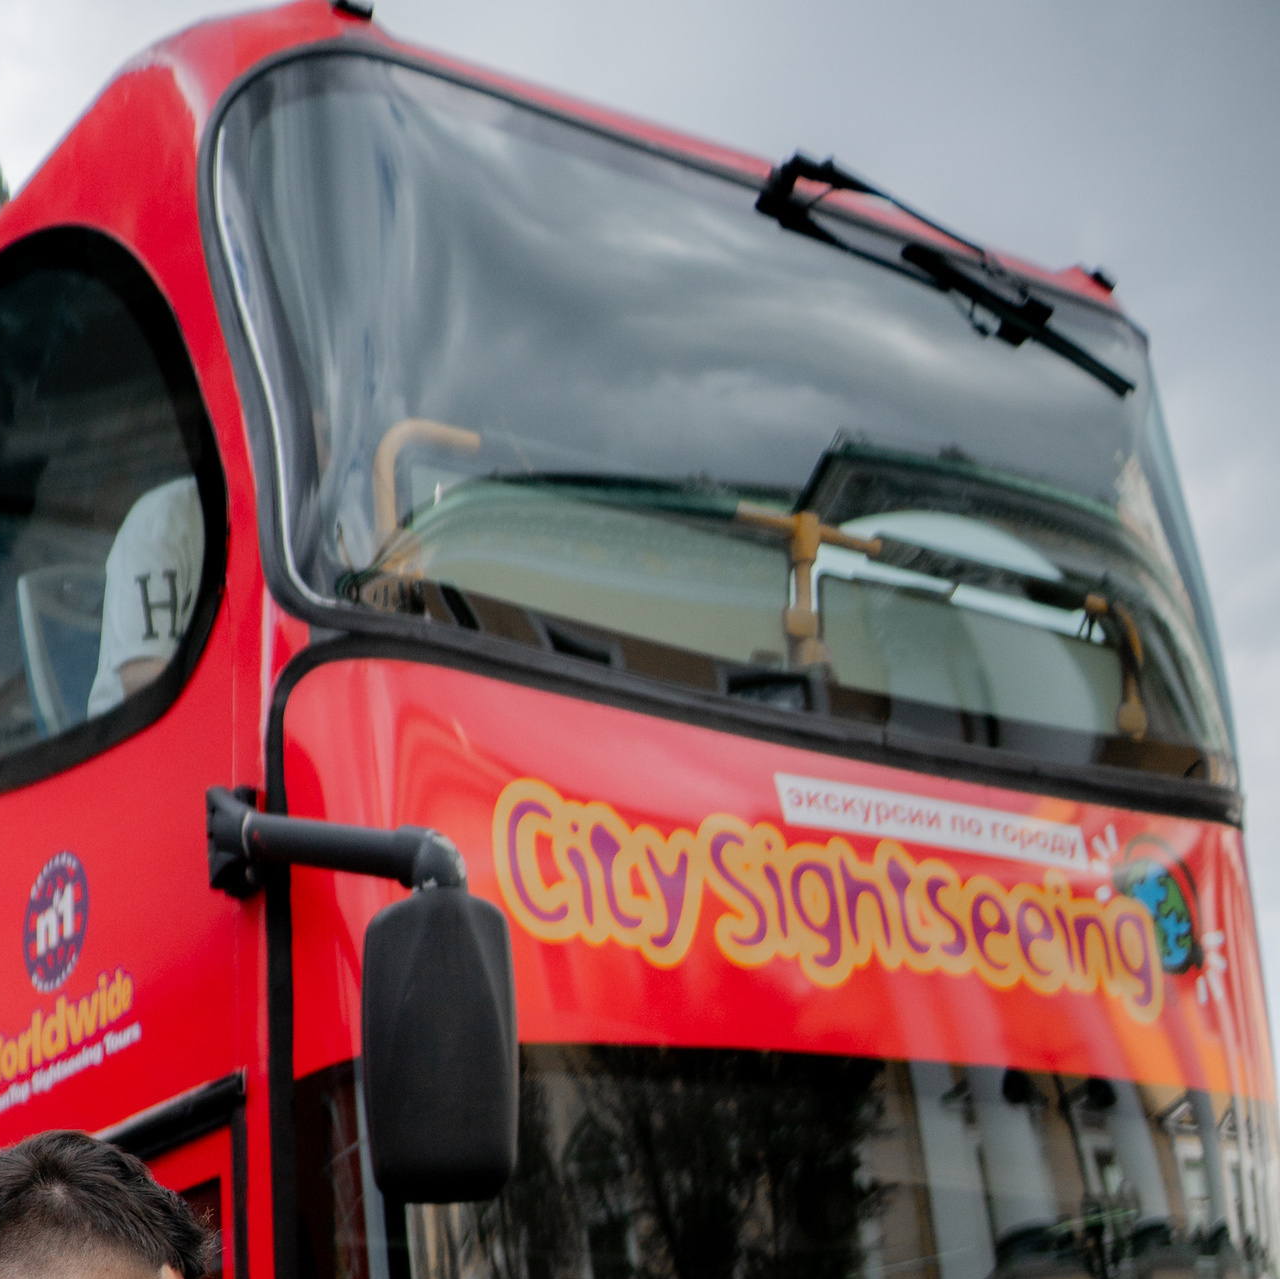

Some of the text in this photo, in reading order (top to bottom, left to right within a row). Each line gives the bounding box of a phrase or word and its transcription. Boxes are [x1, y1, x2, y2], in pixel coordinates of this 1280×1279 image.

[786, 786, 1079, 860] экскурсии по городу
[103, 1021, 142, 1055] Tours
